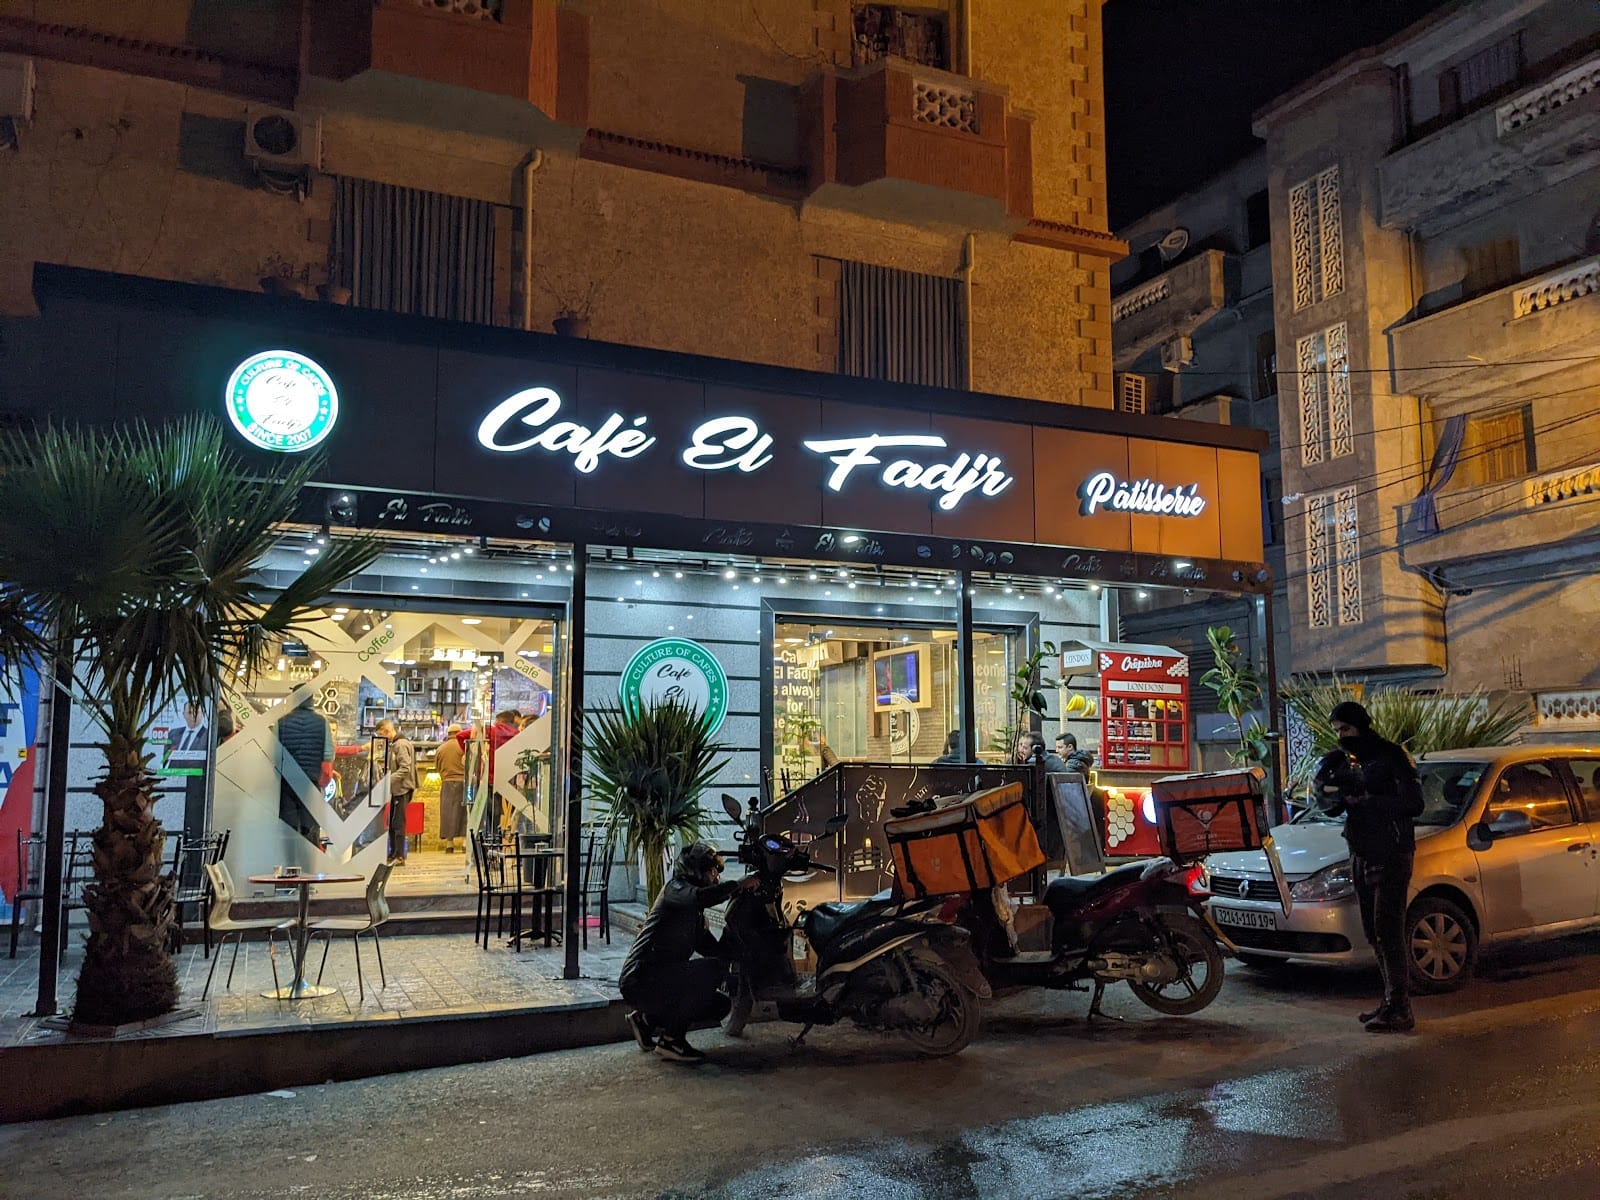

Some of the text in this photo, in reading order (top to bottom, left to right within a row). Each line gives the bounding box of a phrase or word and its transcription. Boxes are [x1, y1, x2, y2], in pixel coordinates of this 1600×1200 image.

[247, 422, 312, 445] SINCE 2007
[478, 386, 1014, 511] Café El Fadjr
[1085, 472, 1206, 516] Pâtisserie
[358, 630, 395, 662] Coffee
[514, 658, 541, 679] Café
[632, 647, 717, 684] CULTURE OF CAFES
[1065, 654, 1089, 664] LONDON
[657, 664, 692, 681] Café
[1127, 683, 1164, 691] LONDON
[229, 693, 251, 720] Café
